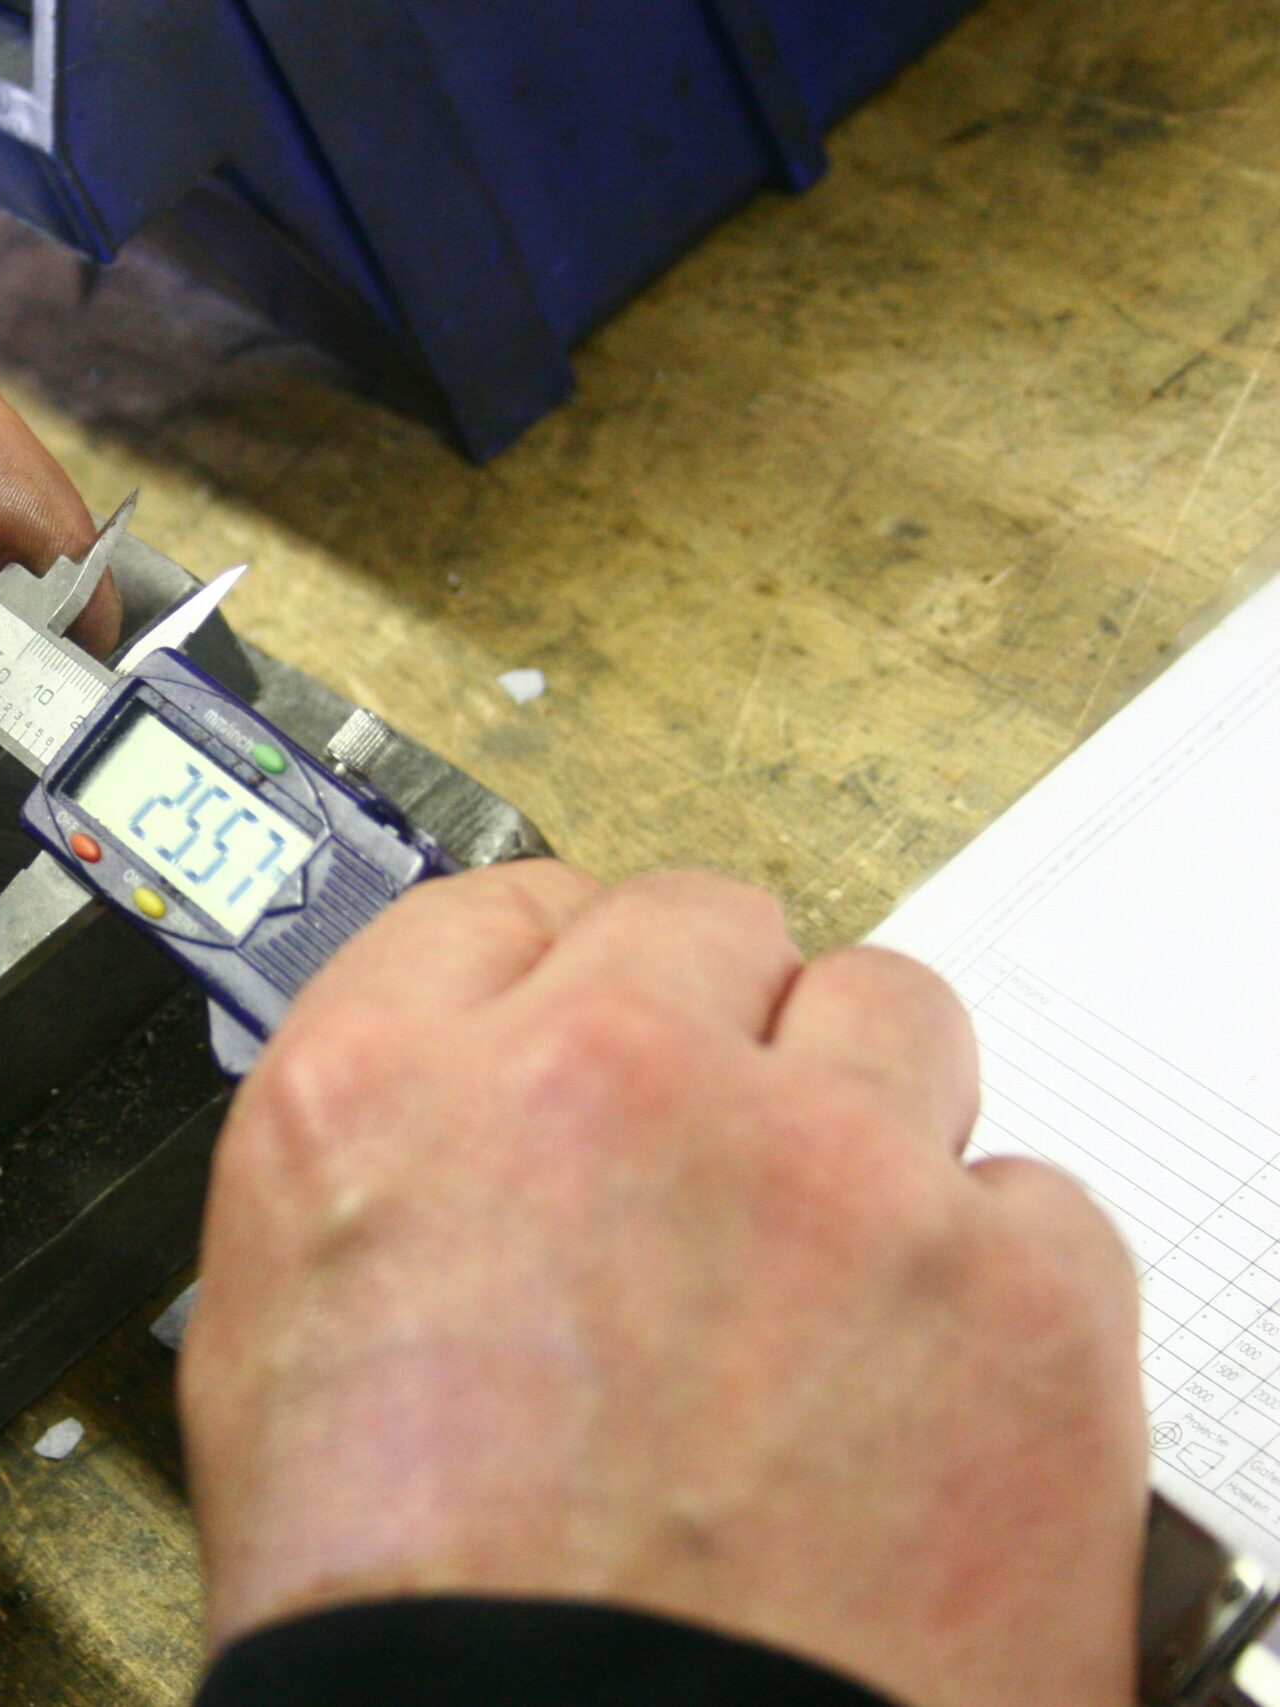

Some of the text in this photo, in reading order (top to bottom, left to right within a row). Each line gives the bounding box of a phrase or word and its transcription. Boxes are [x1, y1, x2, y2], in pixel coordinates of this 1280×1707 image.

[33, 684, 55, 706] 10
[3, 702, 14, 713] 2
[14, 711, 24, 721] 3
[24, 720, 34, 729] 4
[34, 728, 45, 738] 5
[55, 810, 81, 832] OFF
[1235, 1339, 1262, 1361] 1000
[1212, 1360, 1240, 1381] 1500
[1185, 1380, 1215, 1404] 2000
